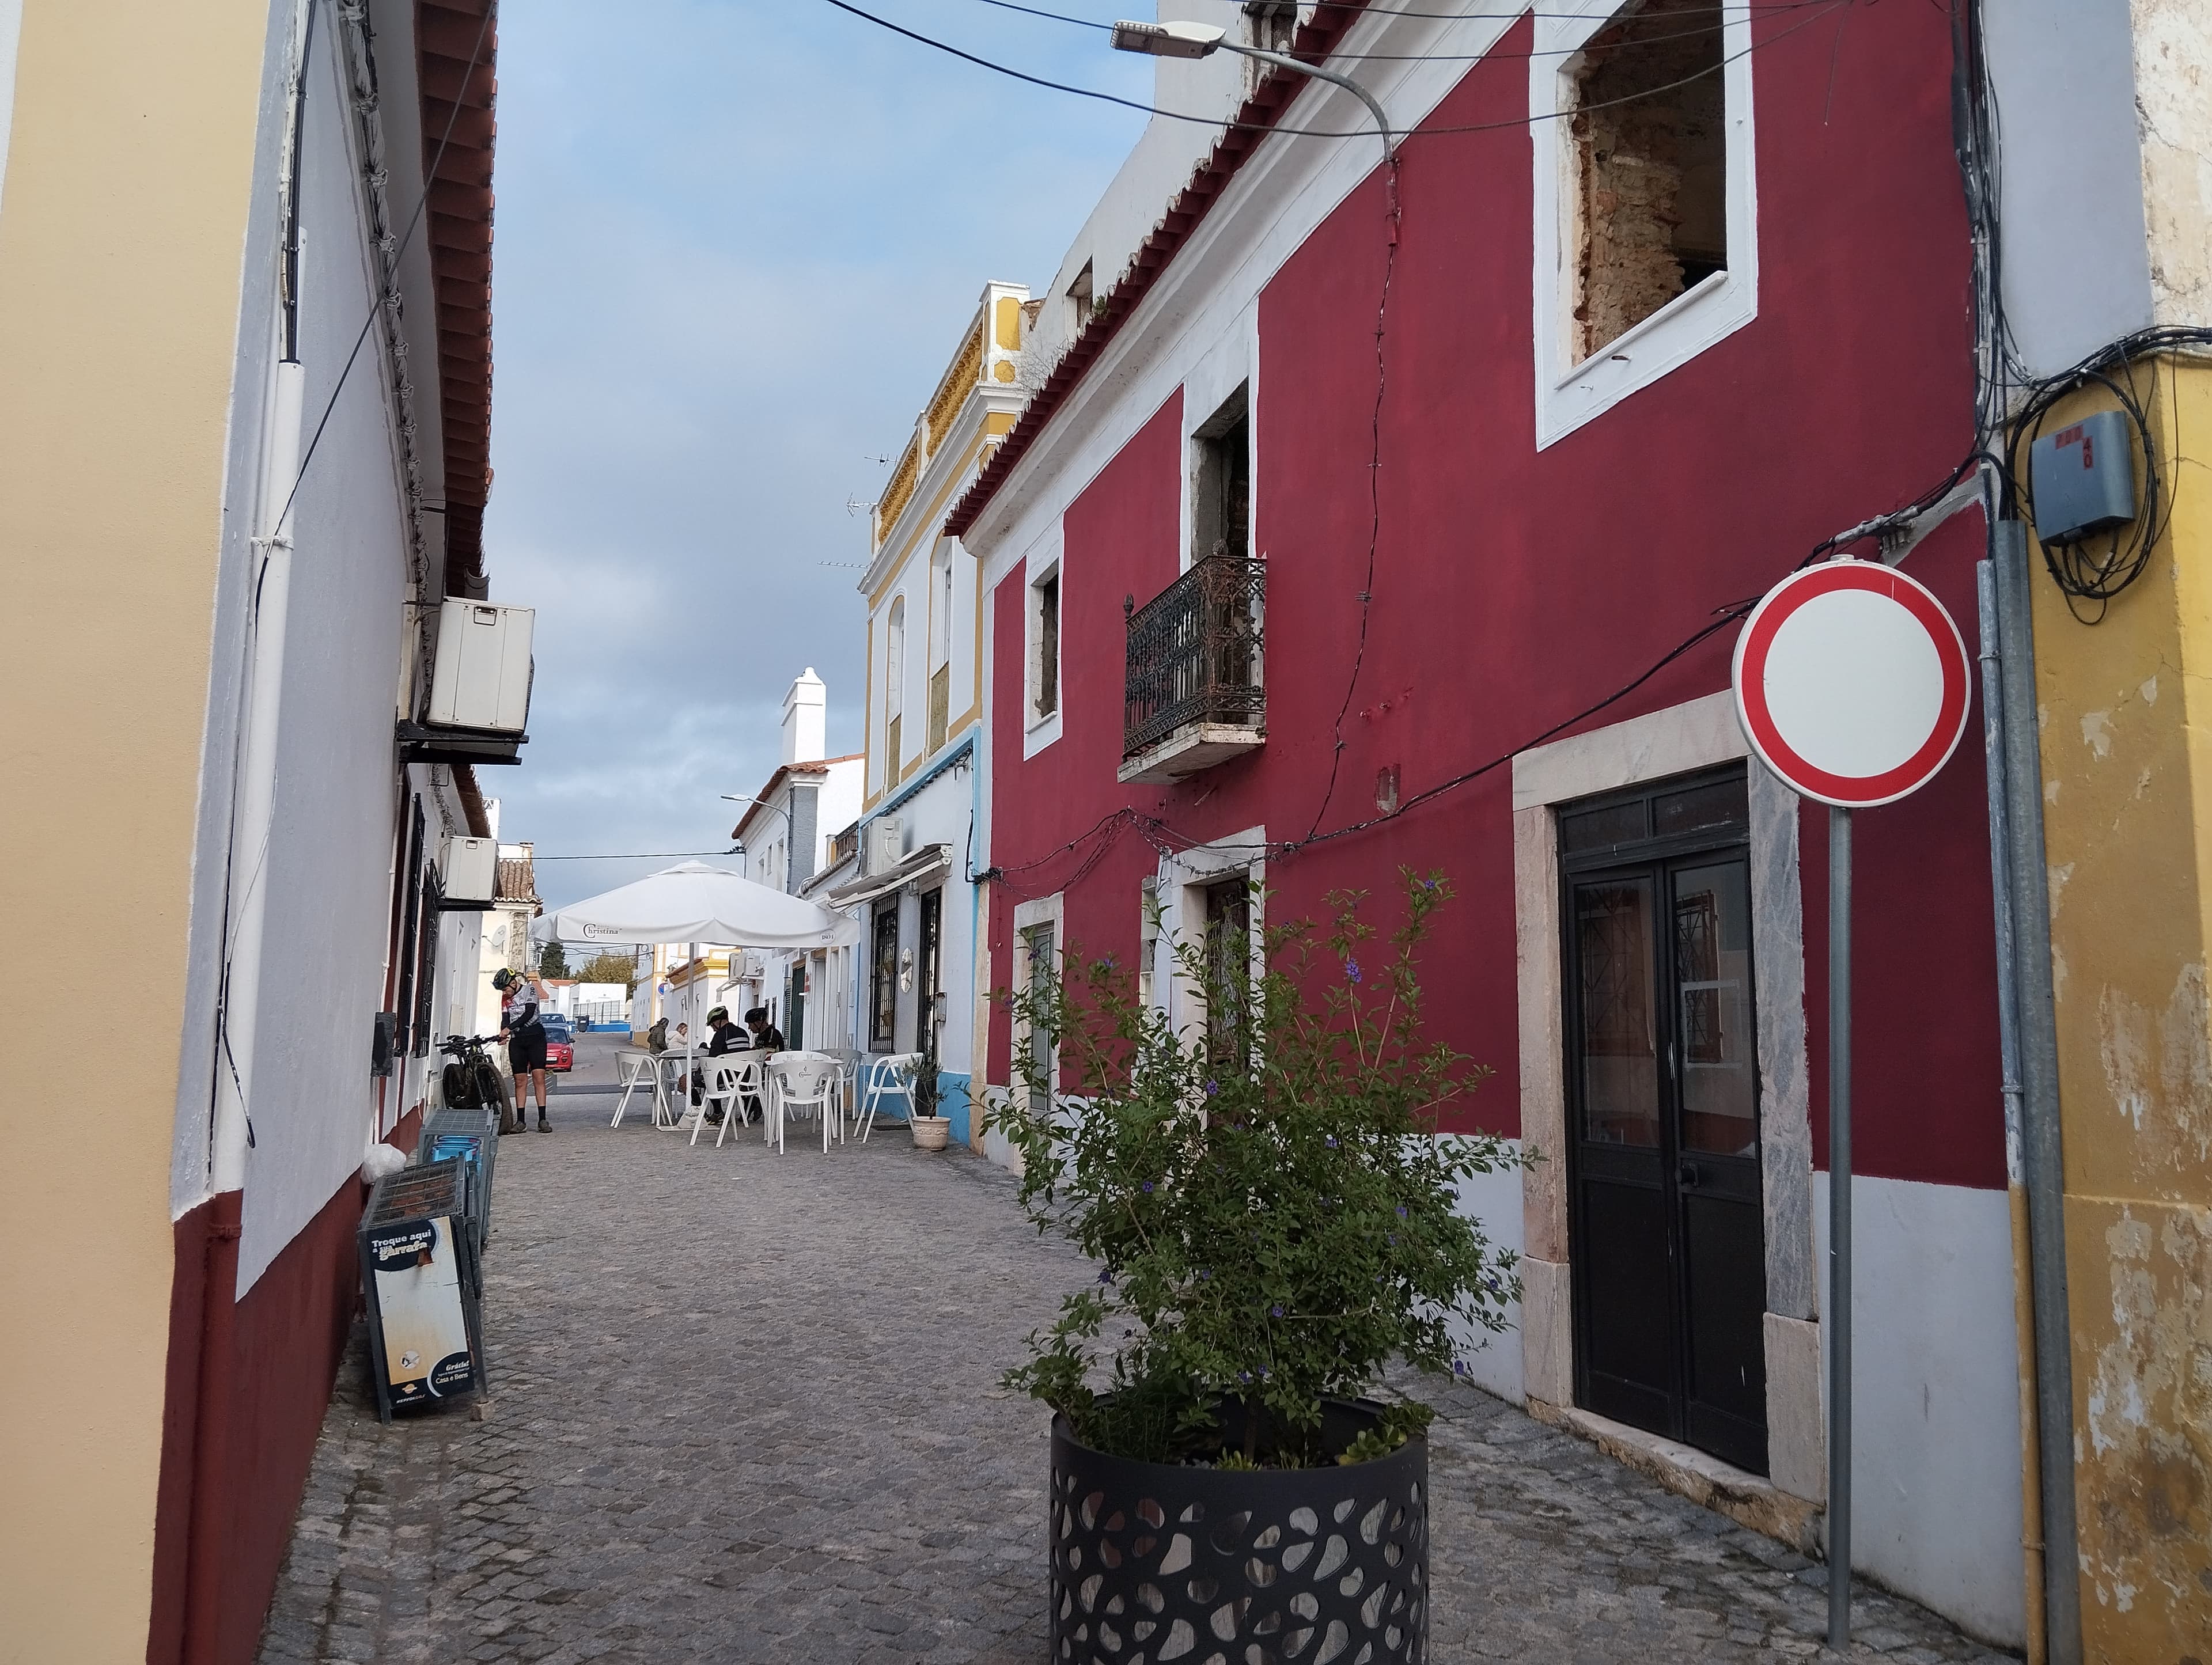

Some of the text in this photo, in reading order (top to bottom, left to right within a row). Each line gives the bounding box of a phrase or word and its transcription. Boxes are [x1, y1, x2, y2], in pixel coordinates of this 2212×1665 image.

[583, 923, 618, 938] Christina
[372, 1229, 431, 1247] Troque aqui
[379, 1241, 427, 1261] garrafa
[454, 1372, 468, 1380] Bens
